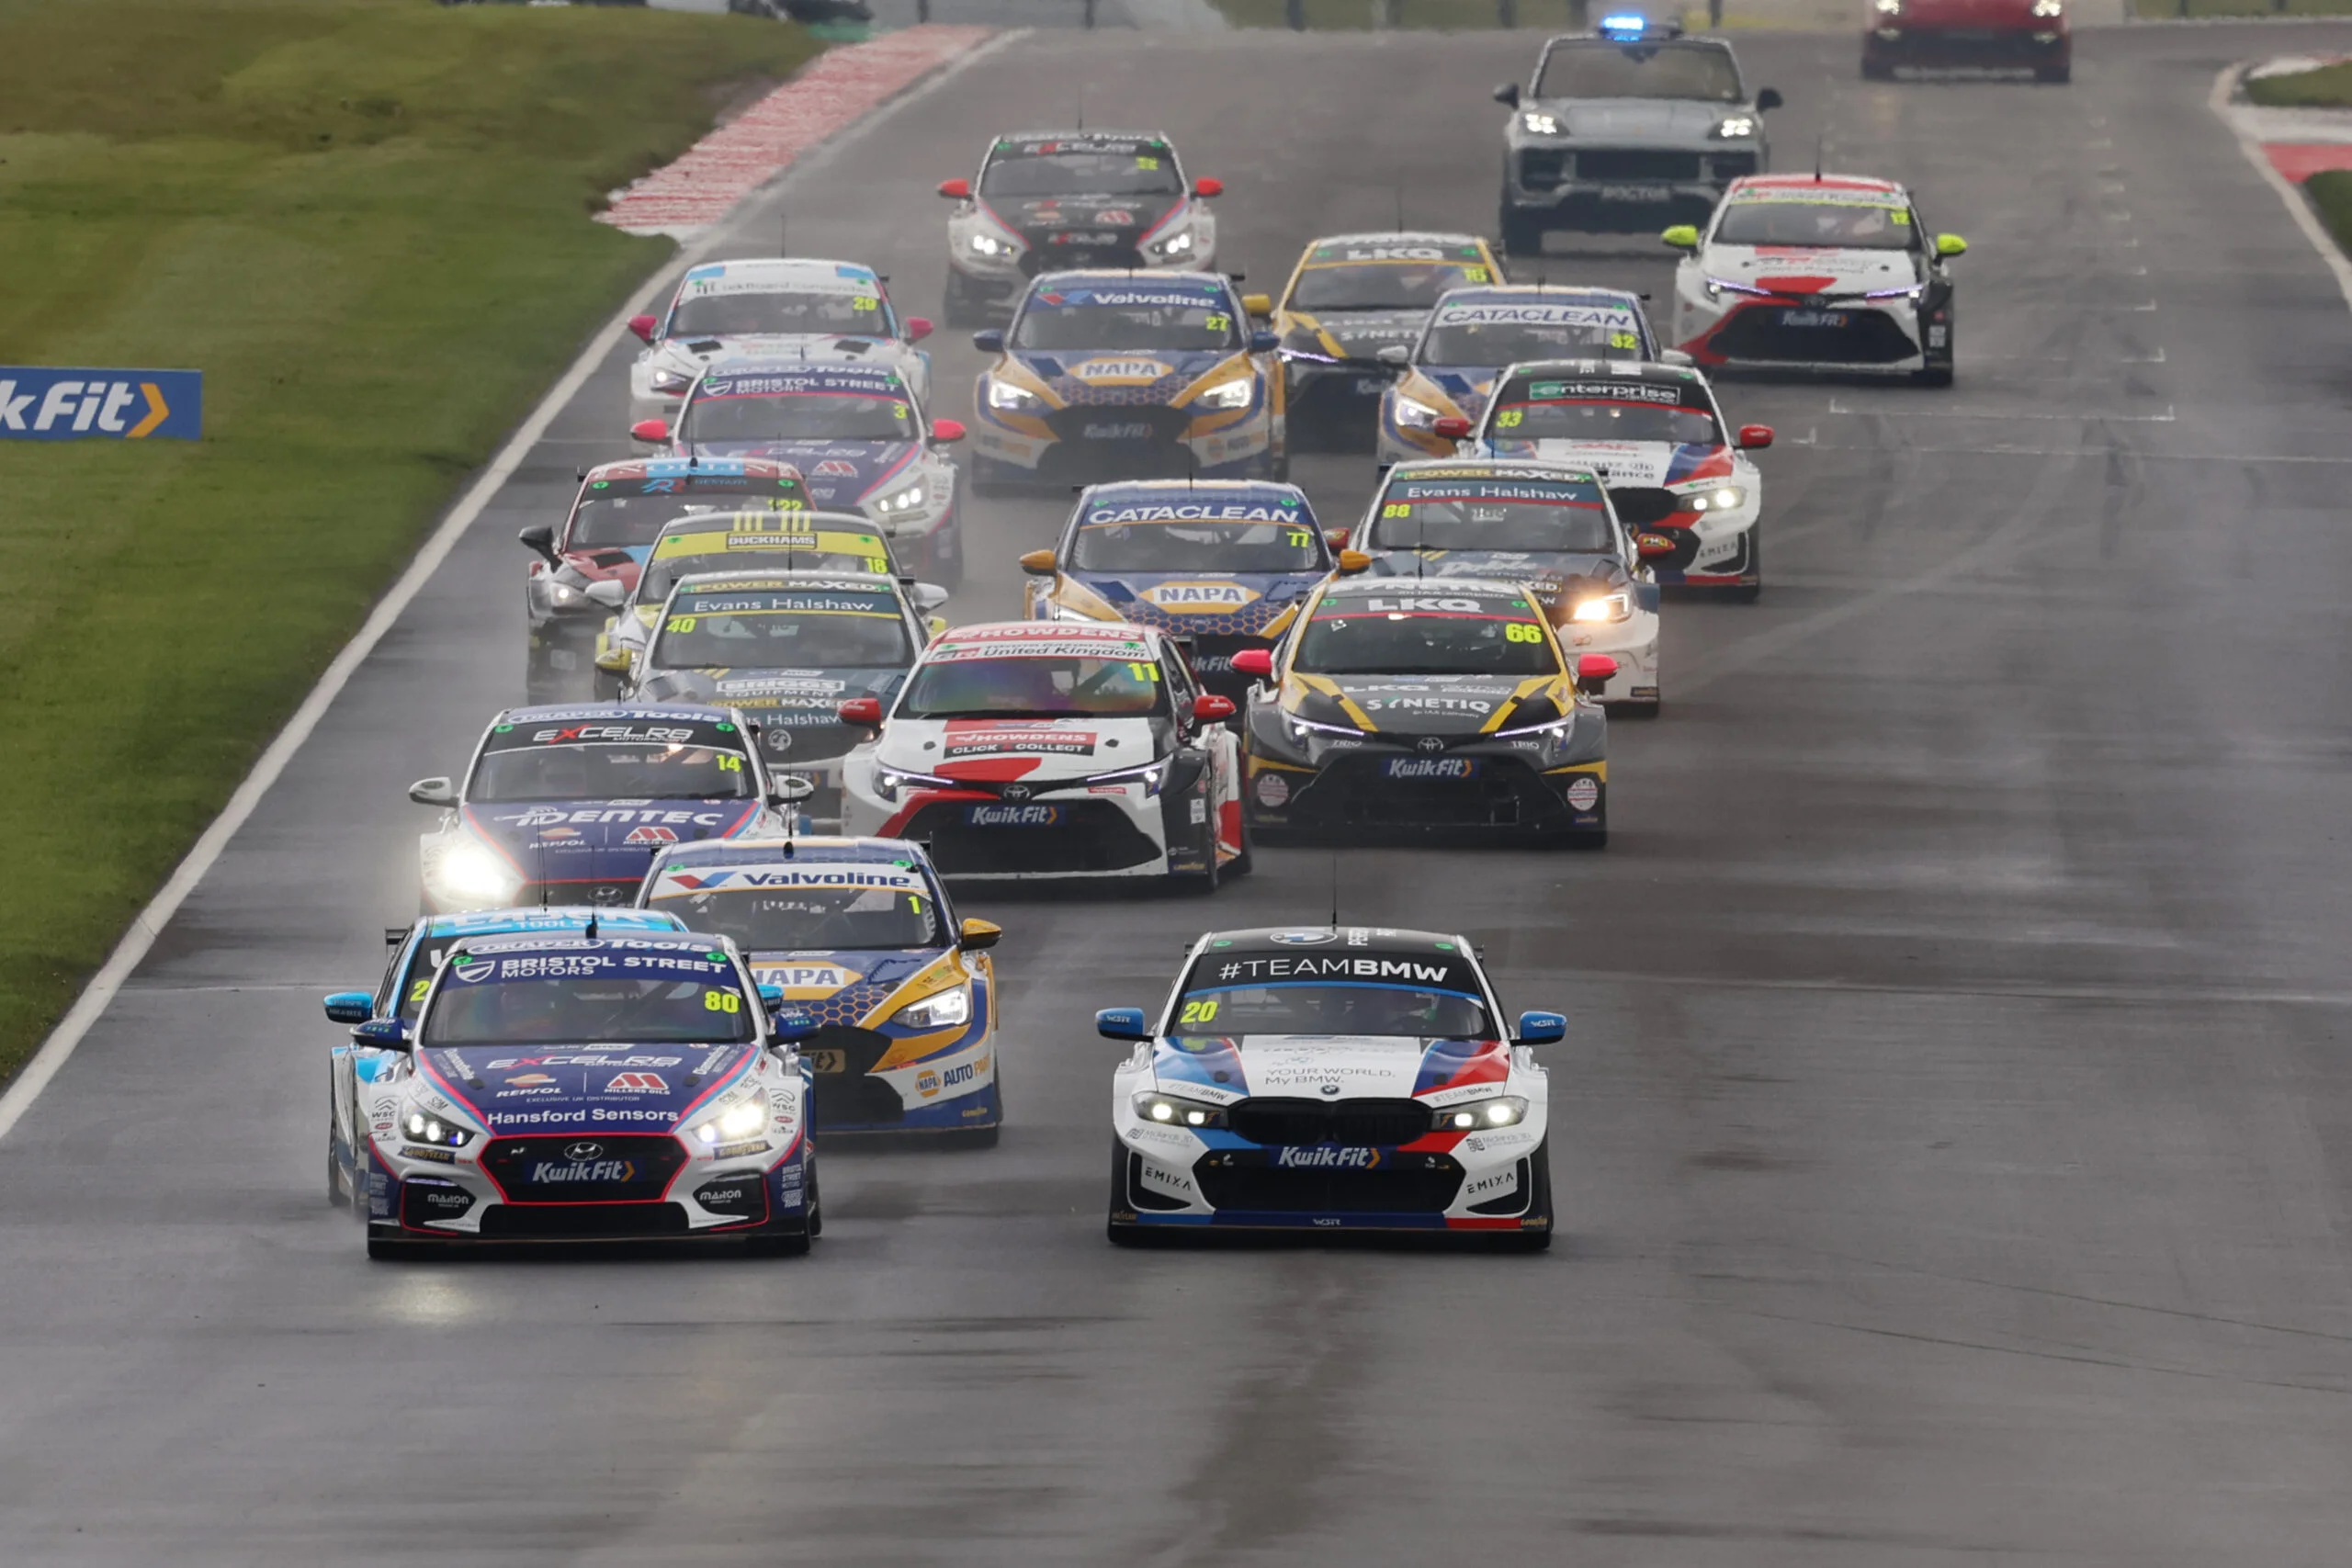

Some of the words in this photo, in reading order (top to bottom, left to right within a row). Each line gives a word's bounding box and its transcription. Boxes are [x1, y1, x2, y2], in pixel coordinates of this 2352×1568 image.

[1347, 248, 1444, 260] LKQ
[1093, 293, 1216, 307] Valvoline
[1205, 316, 1228, 331] 27
[1442, 309, 1630, 326] CATACLEAN
[1611, 334, 1636, 349] 32
[1084, 363, 1158, 376] NAPA
[736, 378, 820, 387] BRISTOL
[825, 378, 901, 392] STREET
[736, 385, 805, 394] MOTORS
[894, 405, 908, 419] 3
[1497, 411, 1523, 428] 33
[1408, 488, 1471, 498] Evans
[1480, 487, 1577, 501] Halshaw
[1089, 506, 1298, 523] CATACLEAN
[1383, 504, 1411, 518] 88
[728, 536, 816, 545] DUCKHAMS
[1287, 531, 1310, 547] 77
[865, 557, 888, 574] 18
[1159, 586, 1242, 602] NAPA
[695, 601, 763, 612] Evans
[772, 599, 875, 611] Halshaw
[1368, 598, 1484, 613] LKQ
[667, 618, 698, 633] 40
[978, 626, 1140, 640] HOWDENS
[1505, 623, 1542, 643] 66
[984, 649, 1049, 658] United
[1056, 647, 1146, 659] Kingdom
[1127, 662, 1159, 682] 11
[1367, 696, 1491, 713] SYNETIQ
[627, 711, 722, 722] Tools
[976, 734, 1087, 742] HOWDENS
[952, 744, 999, 754] CLICK
[1015, 742, 1085, 752] COLLECT
[716, 754, 742, 773] 14
[742, 871, 910, 887] Valvoline
[908, 896, 921, 914] 1
[516, 920, 585, 929] TOOLS
[602, 939, 714, 953] Tools
[501, 965, 594, 978] MOTORS
[502, 956, 616, 970] BRISTOL
[624, 956, 727, 973] STREET
[1218, 958, 1448, 982] #TEAMBMW
[704, 991, 740, 1013] 80
[1179, 1001, 1219, 1023] 20
[944, 1064, 973, 1088] AUTO
[1266, 1067, 1319, 1076] YOUR
[1323, 1067, 1396, 1078] WORLD.
[919, 1075, 939, 1091] NAPA
[1265, 1077, 1291, 1086] My
[1295, 1076, 1345, 1084] BMW.
[496, 1087, 563, 1099] REPSOL
[487, 1108, 586, 1125] Hansford
[592, 1108, 679, 1122] Sensors
